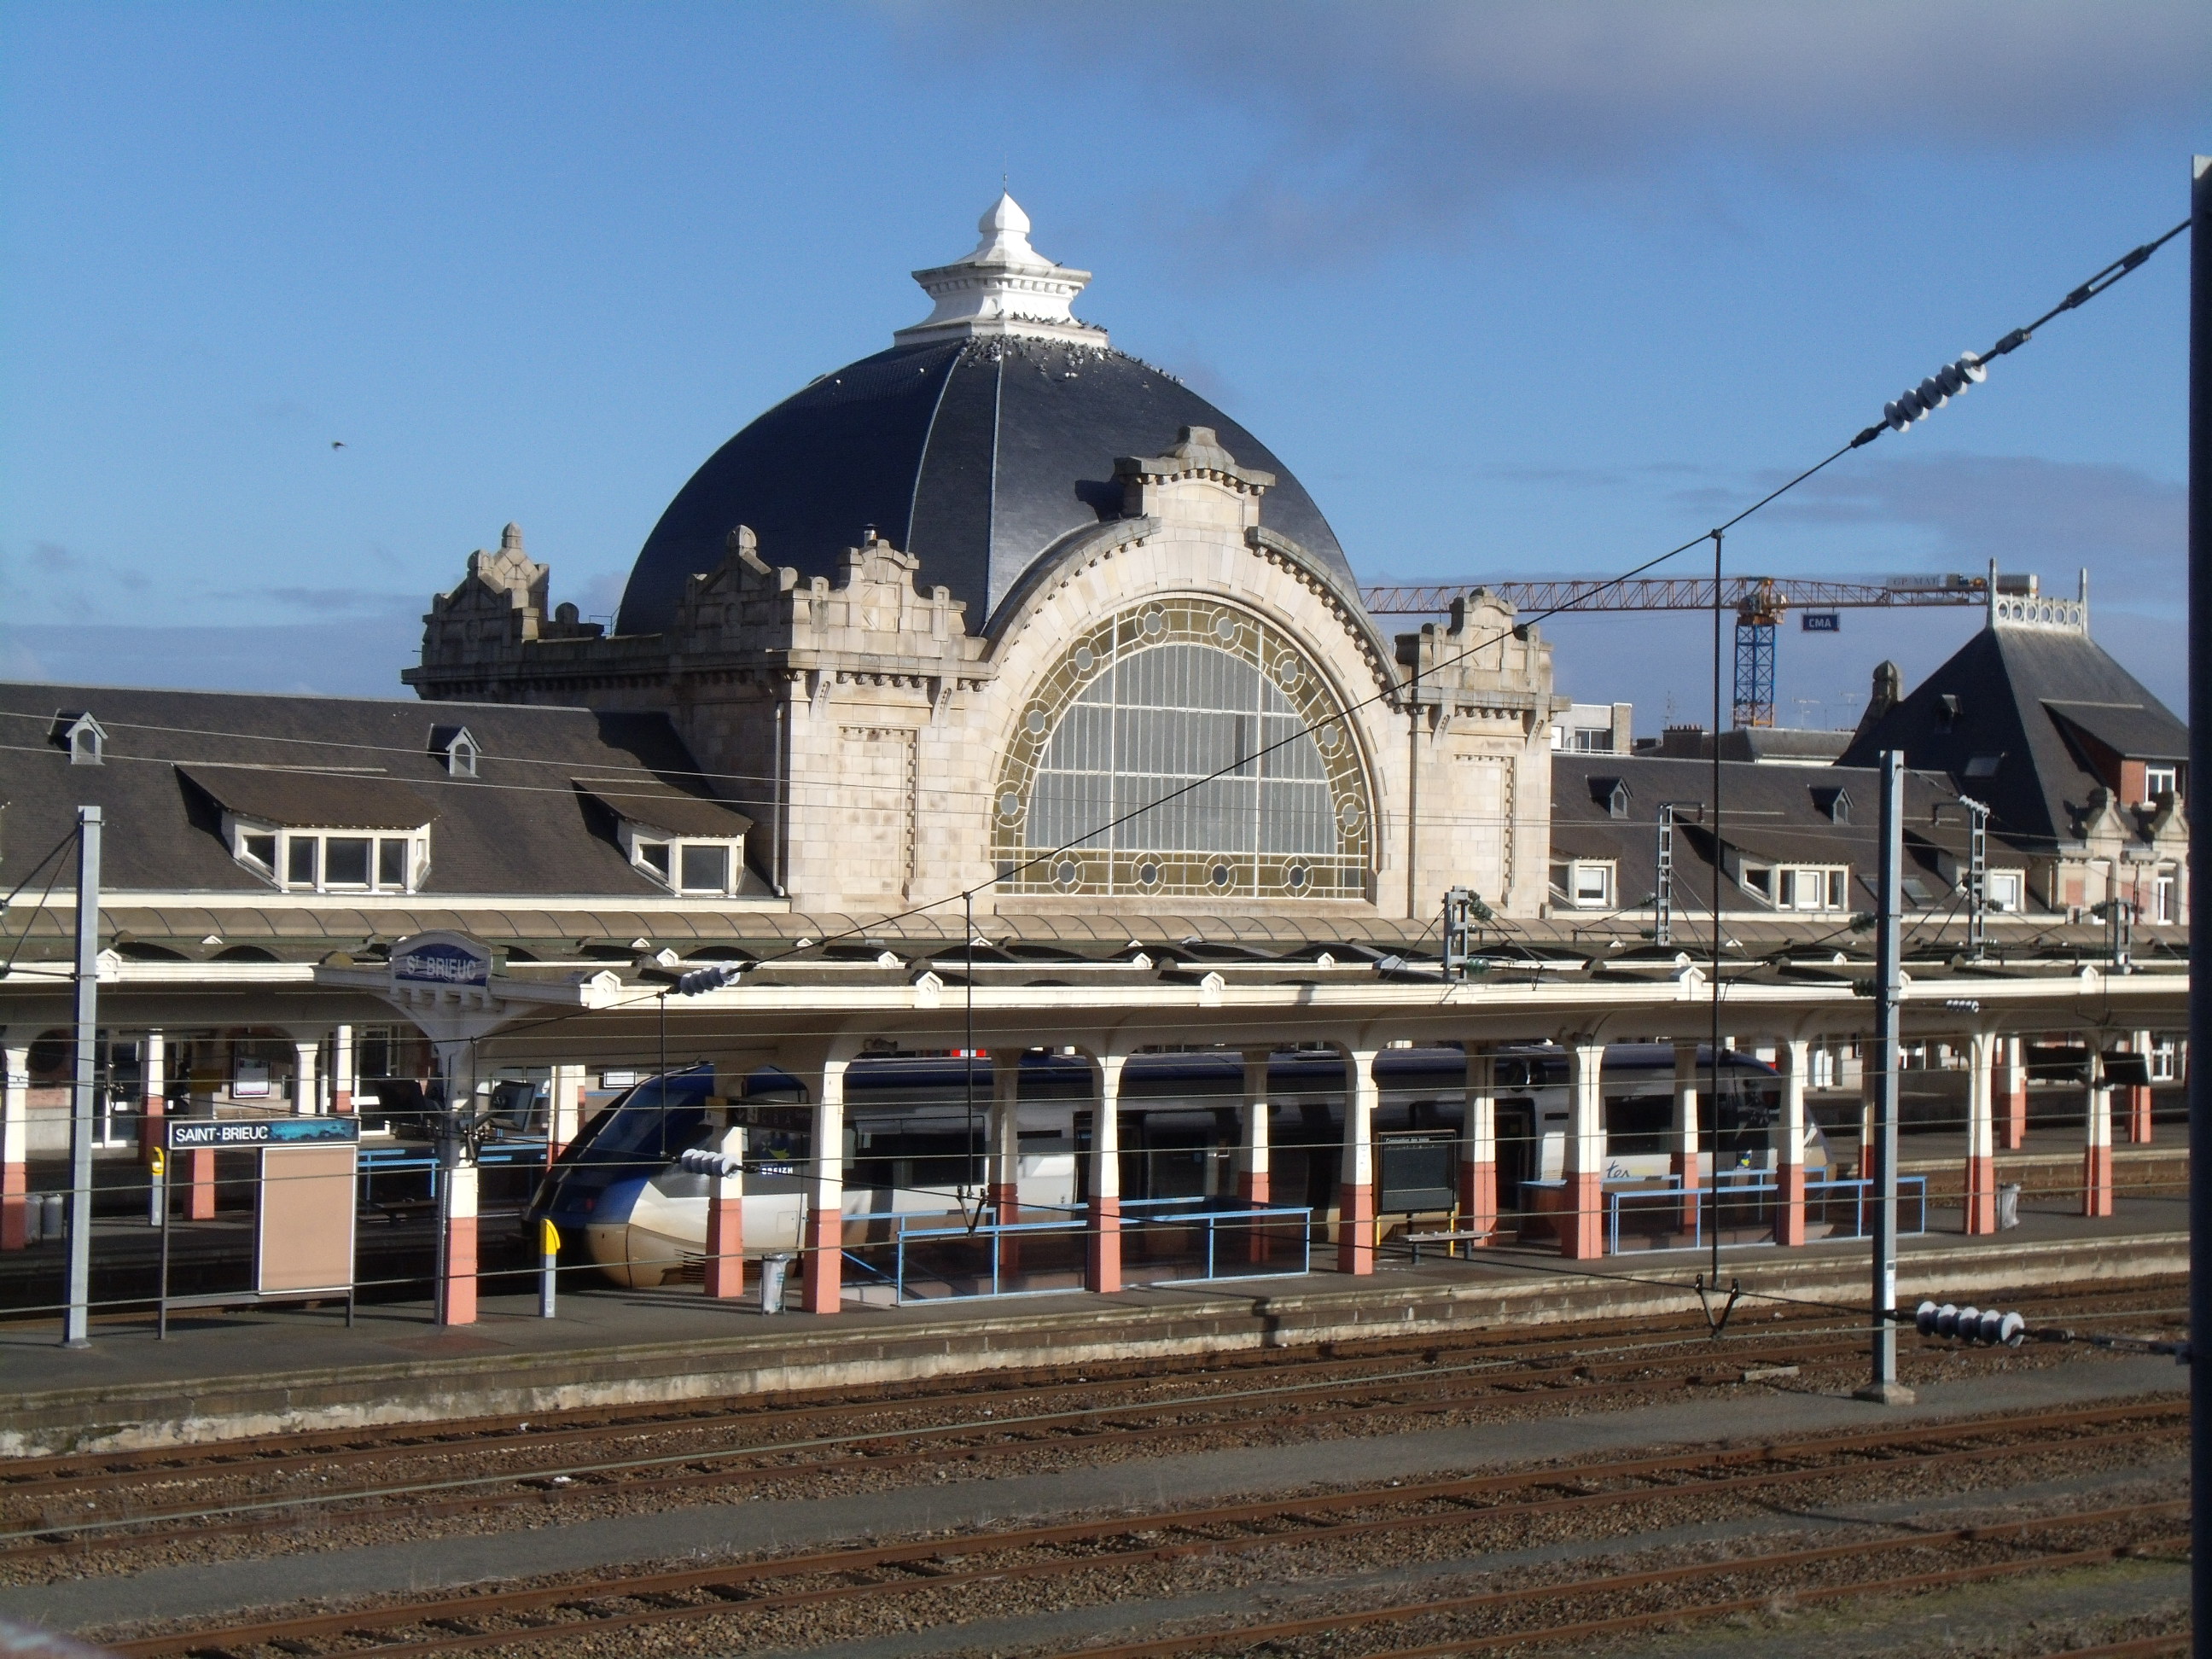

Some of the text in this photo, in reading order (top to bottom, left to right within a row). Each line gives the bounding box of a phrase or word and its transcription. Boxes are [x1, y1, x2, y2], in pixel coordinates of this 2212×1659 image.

[1808, 618, 1831, 628] CMA
[427, 956, 476, 980] BRIEUC
[175, 1126, 269, 1142] SAINT-BRIEUC
